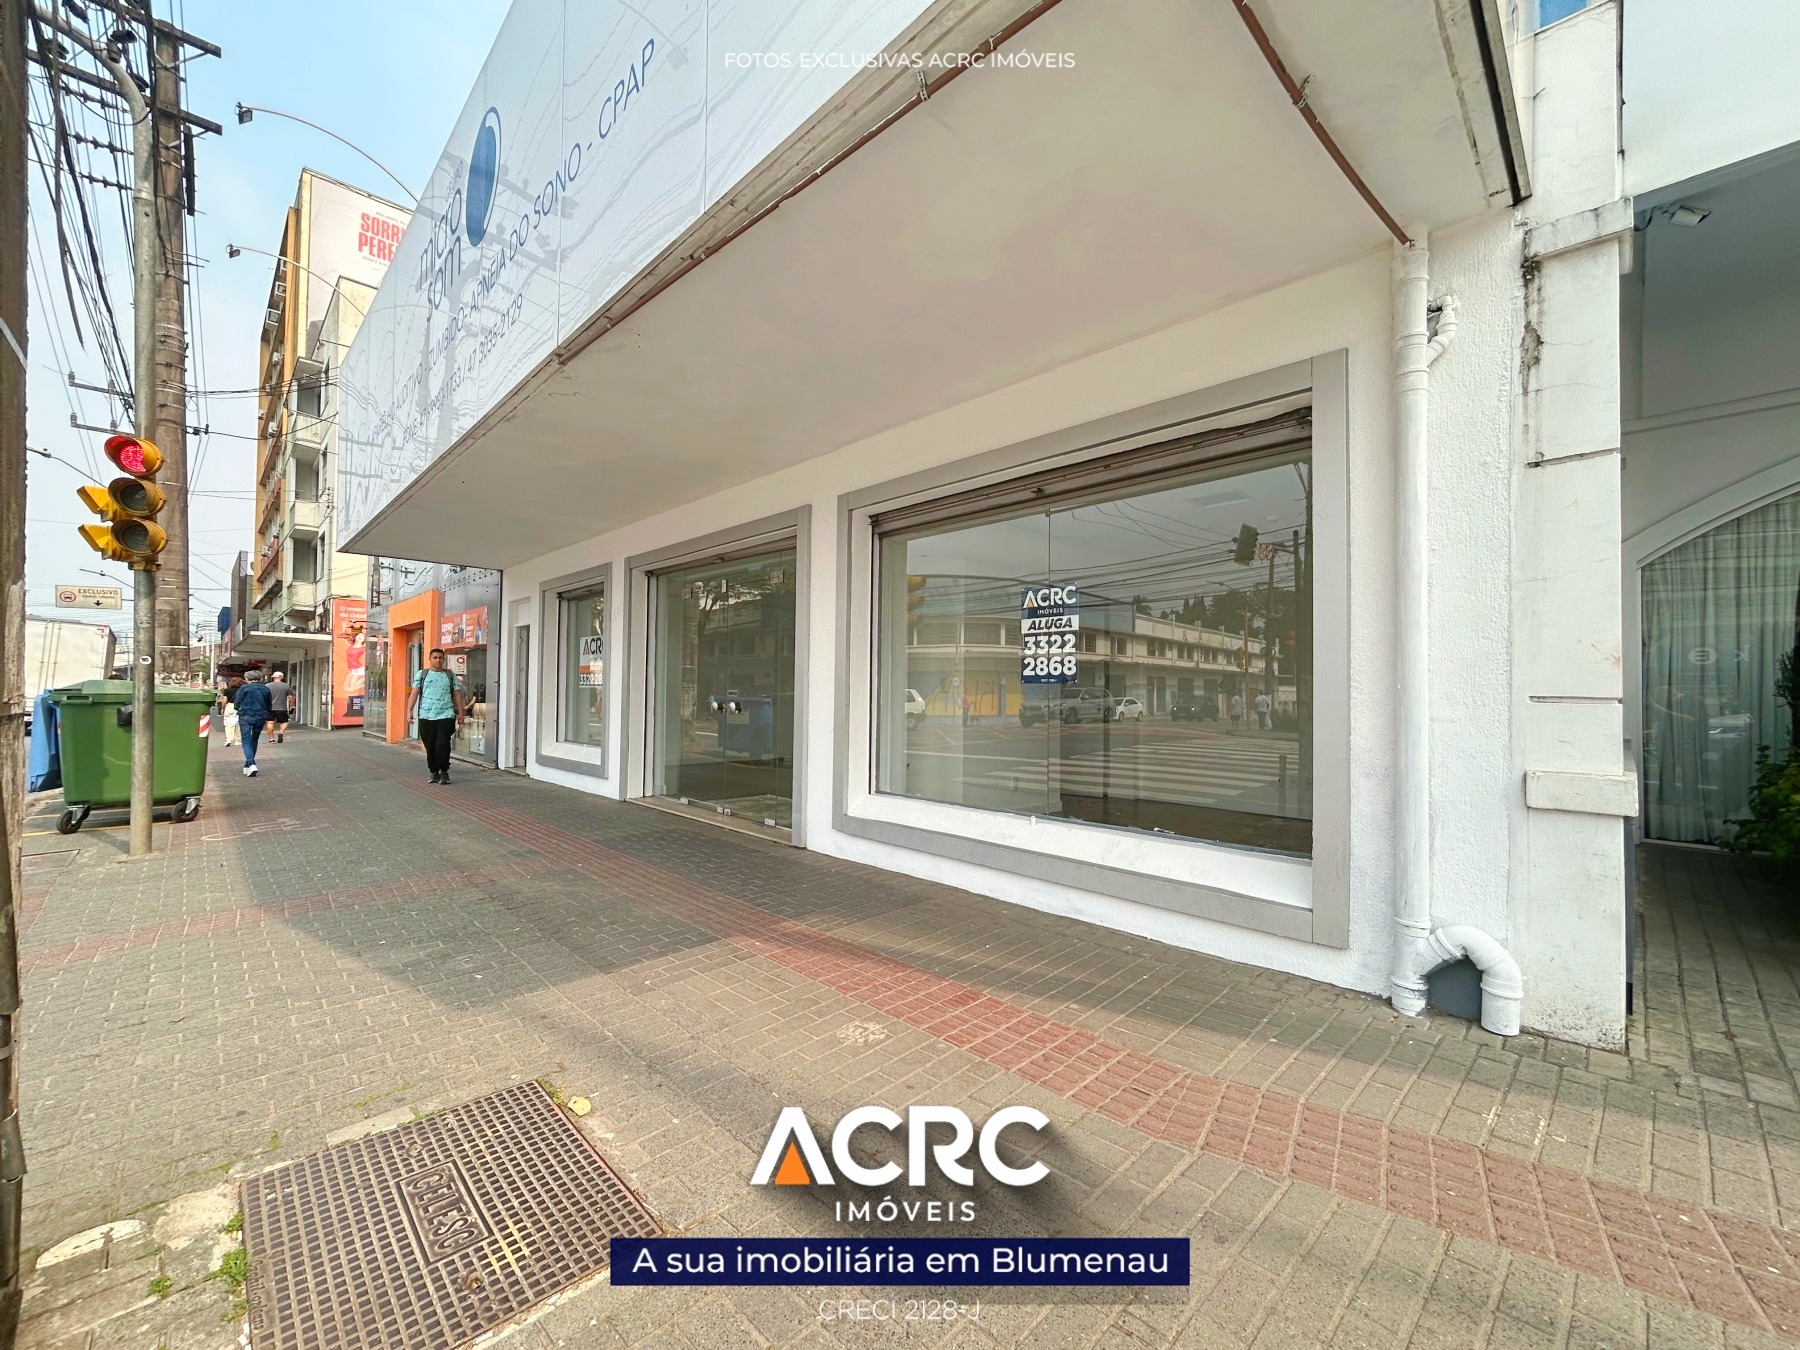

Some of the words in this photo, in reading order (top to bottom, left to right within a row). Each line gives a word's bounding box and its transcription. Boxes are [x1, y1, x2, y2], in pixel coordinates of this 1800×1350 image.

[428, 306, 465, 372] ZUMBIDO
[469, 247, 506, 314] APNEIA
[509, 213, 529, 262] DO
[533, 142, 582, 230] SONO
[599, 38, 655, 140] CPAP
[420, 187, 462, 291] micro
[427, 235, 462, 323] som
[478, 292, 523, 364] 3035-2129
[78, 588, 118, 596] EXCLUSIVO
[1023, 585, 1077, 609] ACRC
[1037, 607, 1064, 615] IMÓVEIS
[1027, 616, 1073, 632] ALUGA
[1024, 633, 1076, 655] 3322
[1022, 655, 1077, 676] 2868
[411, 1172, 476, 1250] CELESC
